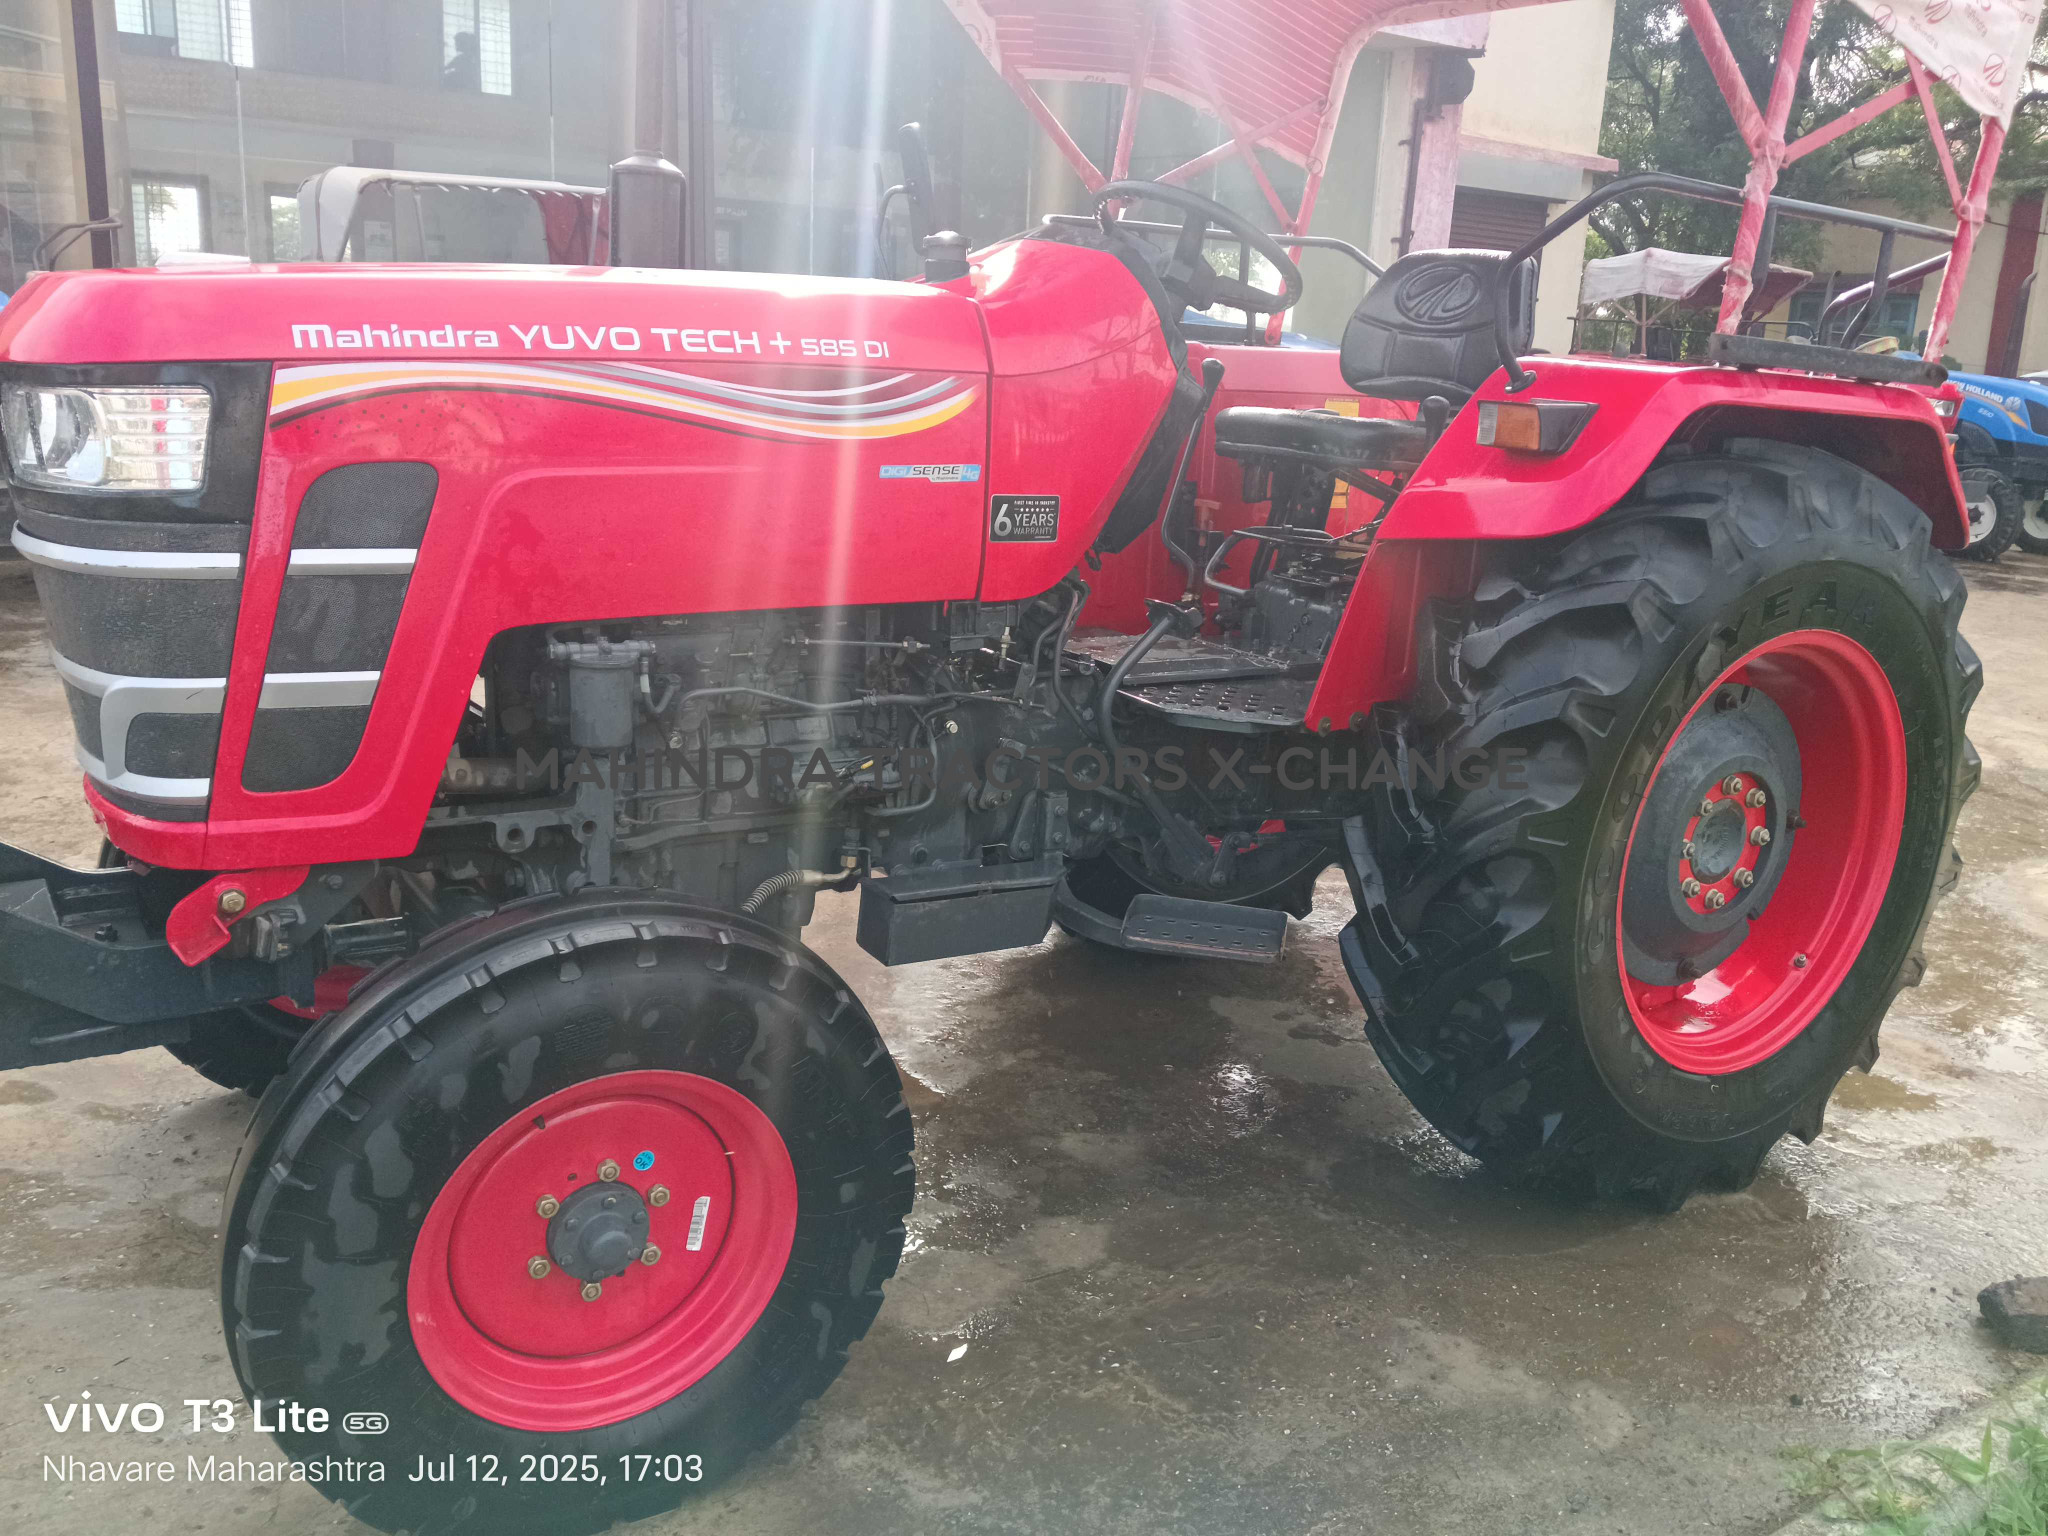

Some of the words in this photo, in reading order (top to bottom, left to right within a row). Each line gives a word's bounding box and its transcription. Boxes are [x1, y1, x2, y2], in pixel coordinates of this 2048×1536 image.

[292, 324, 498, 349] Mahindra
[508, 325, 641, 351] YUVO
[650, 327, 761, 354] TECH
[769, 331, 792, 355] +
[801, 338, 857, 358] 585
[864, 340, 889, 358] DI
[1965, 384, 2003, 403] HOLLAND
[994, 503, 1012, 537] 6
[1013, 527, 1053, 535] WARRANTY
